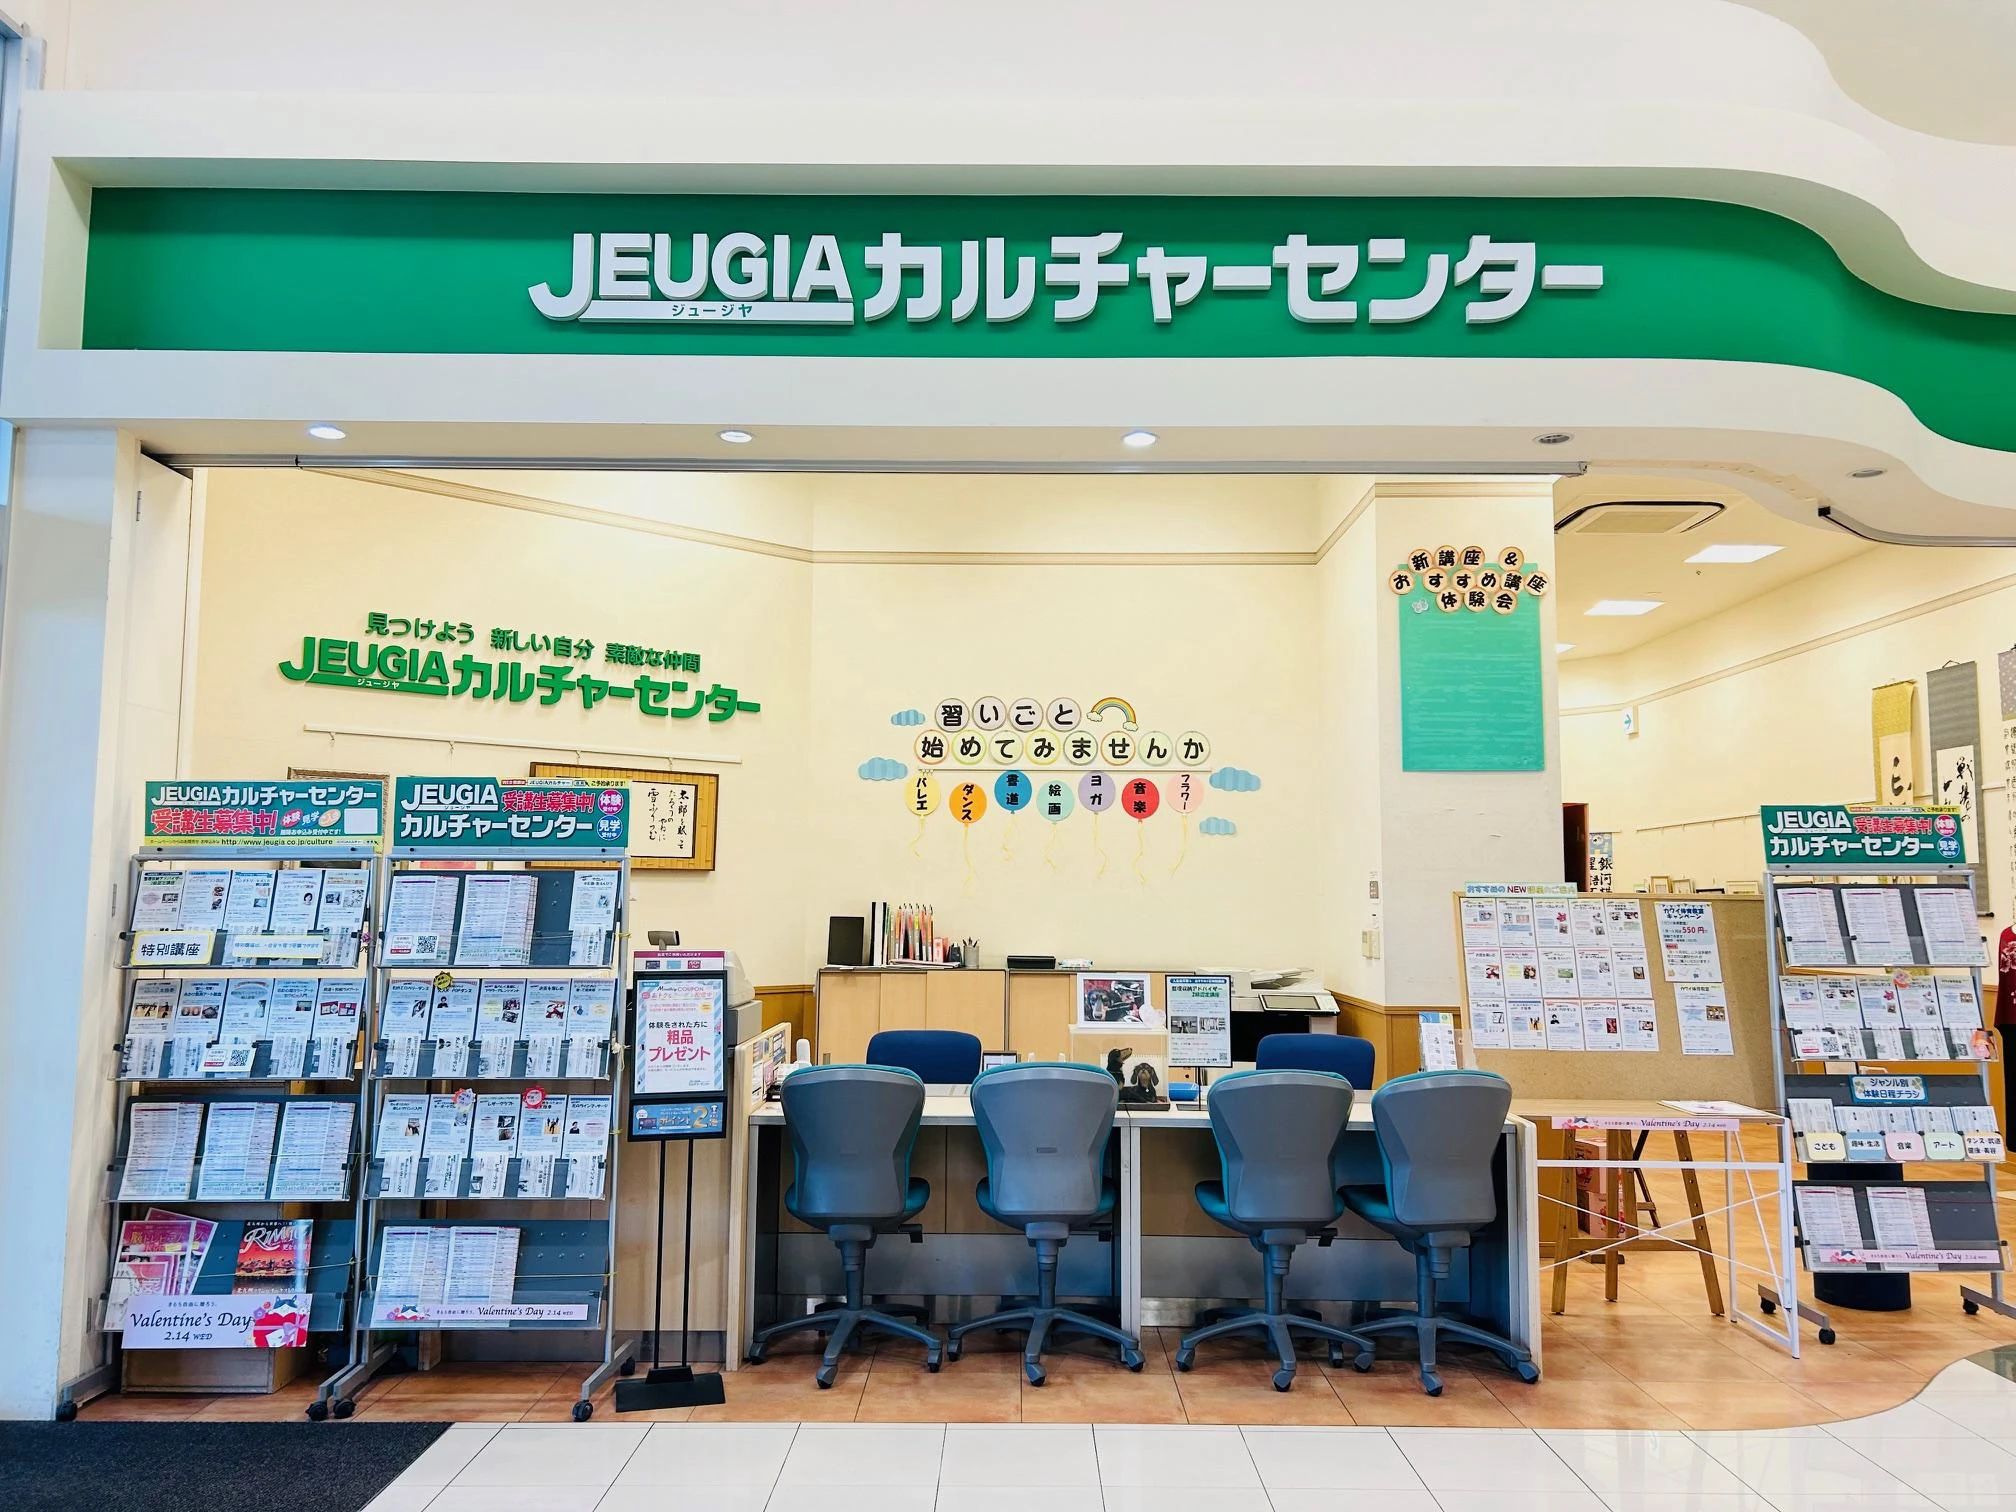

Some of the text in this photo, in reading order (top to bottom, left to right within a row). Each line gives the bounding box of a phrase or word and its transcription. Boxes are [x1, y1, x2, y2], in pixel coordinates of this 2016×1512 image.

[671, 303, 753, 318] ジュージヤ
[1411, 549, 1518, 570] 新講座 &
[1393, 571, 1547, 593] おすすめ講座
[1441, 592, 1513, 609] 体験会
[366, 611, 701, 673] 見つけよう 新しい自分 素敵な仲間
[941, 702, 1074, 728] 習いごと
[921, 735, 1205, 760] 始めてみませんか
[915, 776, 928, 811] バレエ
[1005, 773, 1019, 805] 書道
[1089, 774, 1103, 806] ヨガ
[1180, 774, 1190, 810] フラワー
[401, 784, 498, 811] JEUGIA
[502, 790, 595, 813] 受講生募集中!
[600, 793, 621, 806] 体験
[961, 783, 974, 821] ダンス
[1048, 784, 1061, 815] 絵画
[1133, 782, 1147, 813] 音楽
[152, 808, 278, 835] 受講生募集中!
[282, 811, 301, 826] 体験
[302, 811, 319, 826] 見学
[401, 813, 593, 838] カルチャーセンター
[599, 819, 621, 831] 見学
[1767, 811, 1852, 834] JEUGIA
[1770, 835, 1934, 856] カルチャーセンター
[1938, 840, 1959, 850] 見学
[1507, 885, 1526, 894] NEW
[1682, 926, 1695, 934] 550
[141, 943, 201, 957] 特別講座
[649, 1021, 708, 1029] 体験をされた方に
[667, 1030, 694, 1045] 粗品
[649, 1046, 711, 1062] プレゼント
[1870, 1078, 1909, 1087] ジャンル別
[1863, 1090, 1920, 1098] 体験日程チラシ
[1640, 1118, 1681, 1127] Valentine's
[1683, 1119, 1700, 1130] Day
[1814, 1142, 1836, 1150] こども
[1897, 1142, 1912, 1150] 音楽
[1933, 1141, 1955, 1149] アート
[1905, 1251, 1944, 1260] Valentine's
[1946, 1252, 1961, 1262] Day
[478, 1306, 522, 1316] Valentine's
[525, 1307, 544, 1319] Day
[130, 1310, 254, 1333] Valentine's Day
[164, 1331, 190, 1341] 2.14
